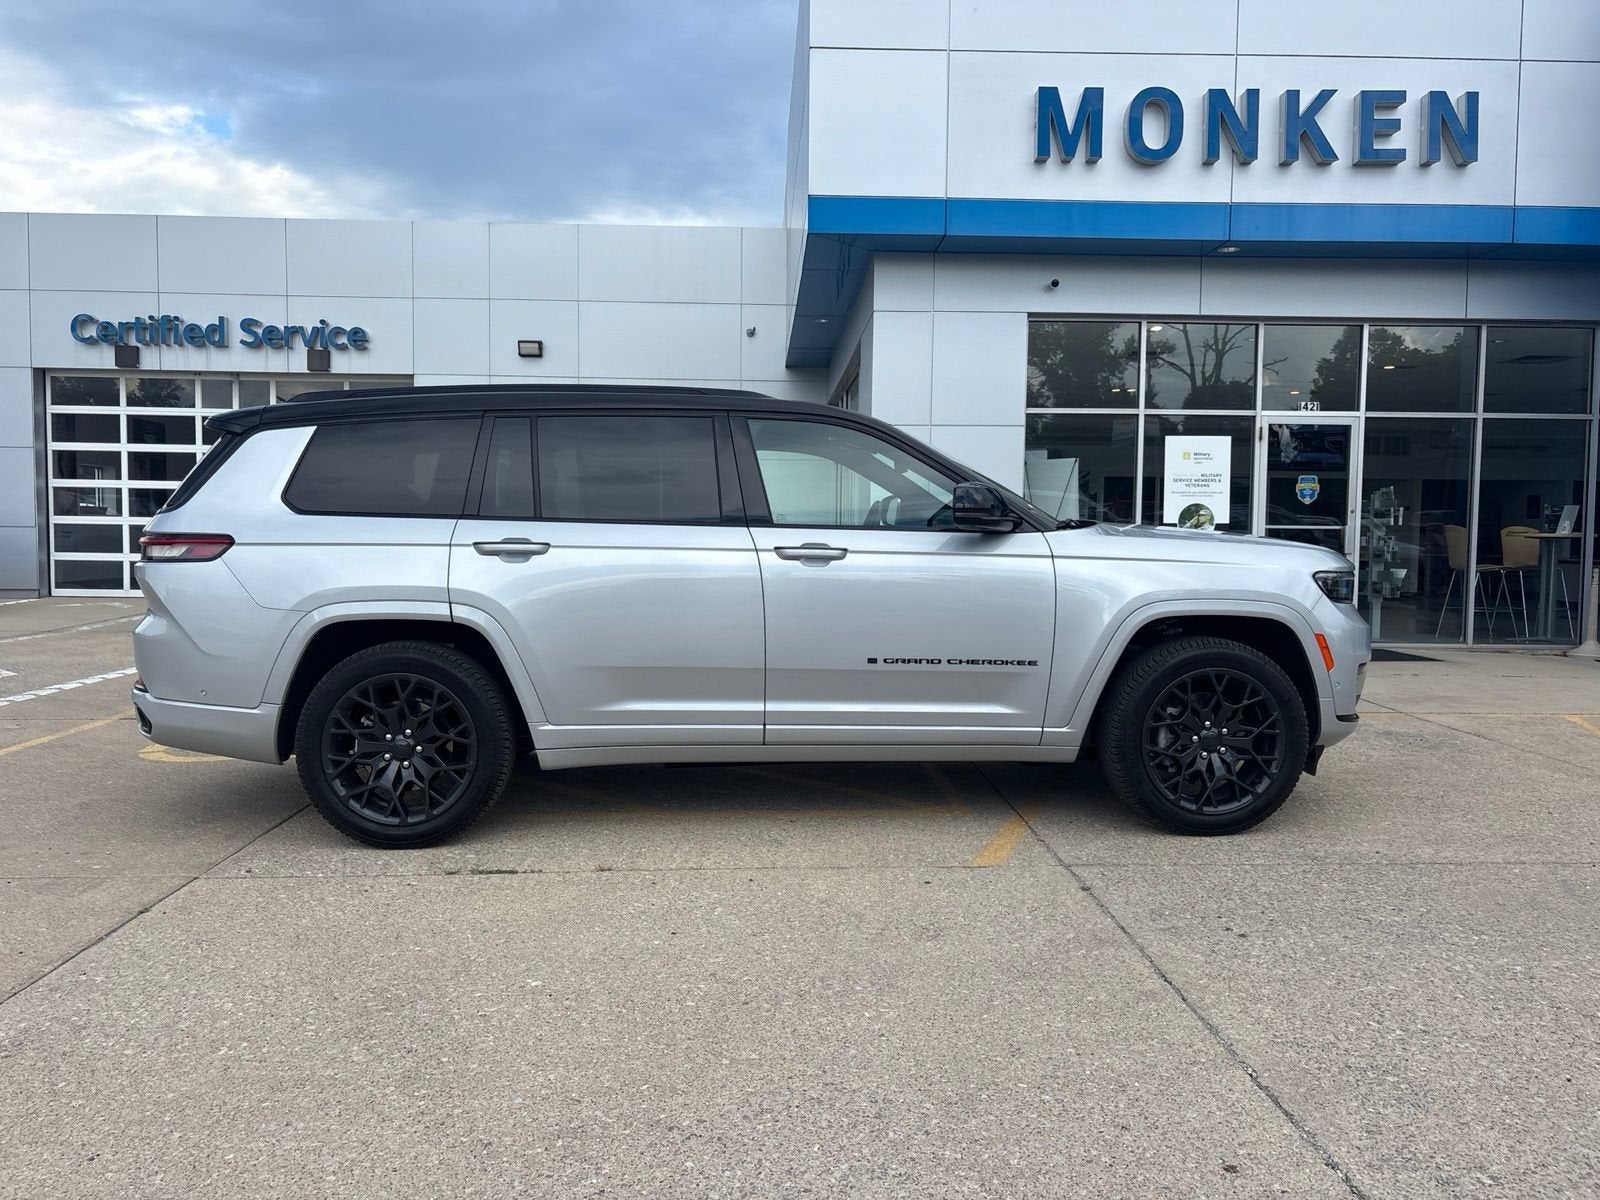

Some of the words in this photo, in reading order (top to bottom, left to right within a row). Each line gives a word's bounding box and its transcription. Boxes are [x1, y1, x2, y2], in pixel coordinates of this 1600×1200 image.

[1034, 86, 1480, 167] MONKEN
[70, 313, 229, 348] Certified
[239, 317, 370, 351] Service
[883, 657, 942, 665] GRAND
[947, 658, 1038, 667] CHEROKEE
